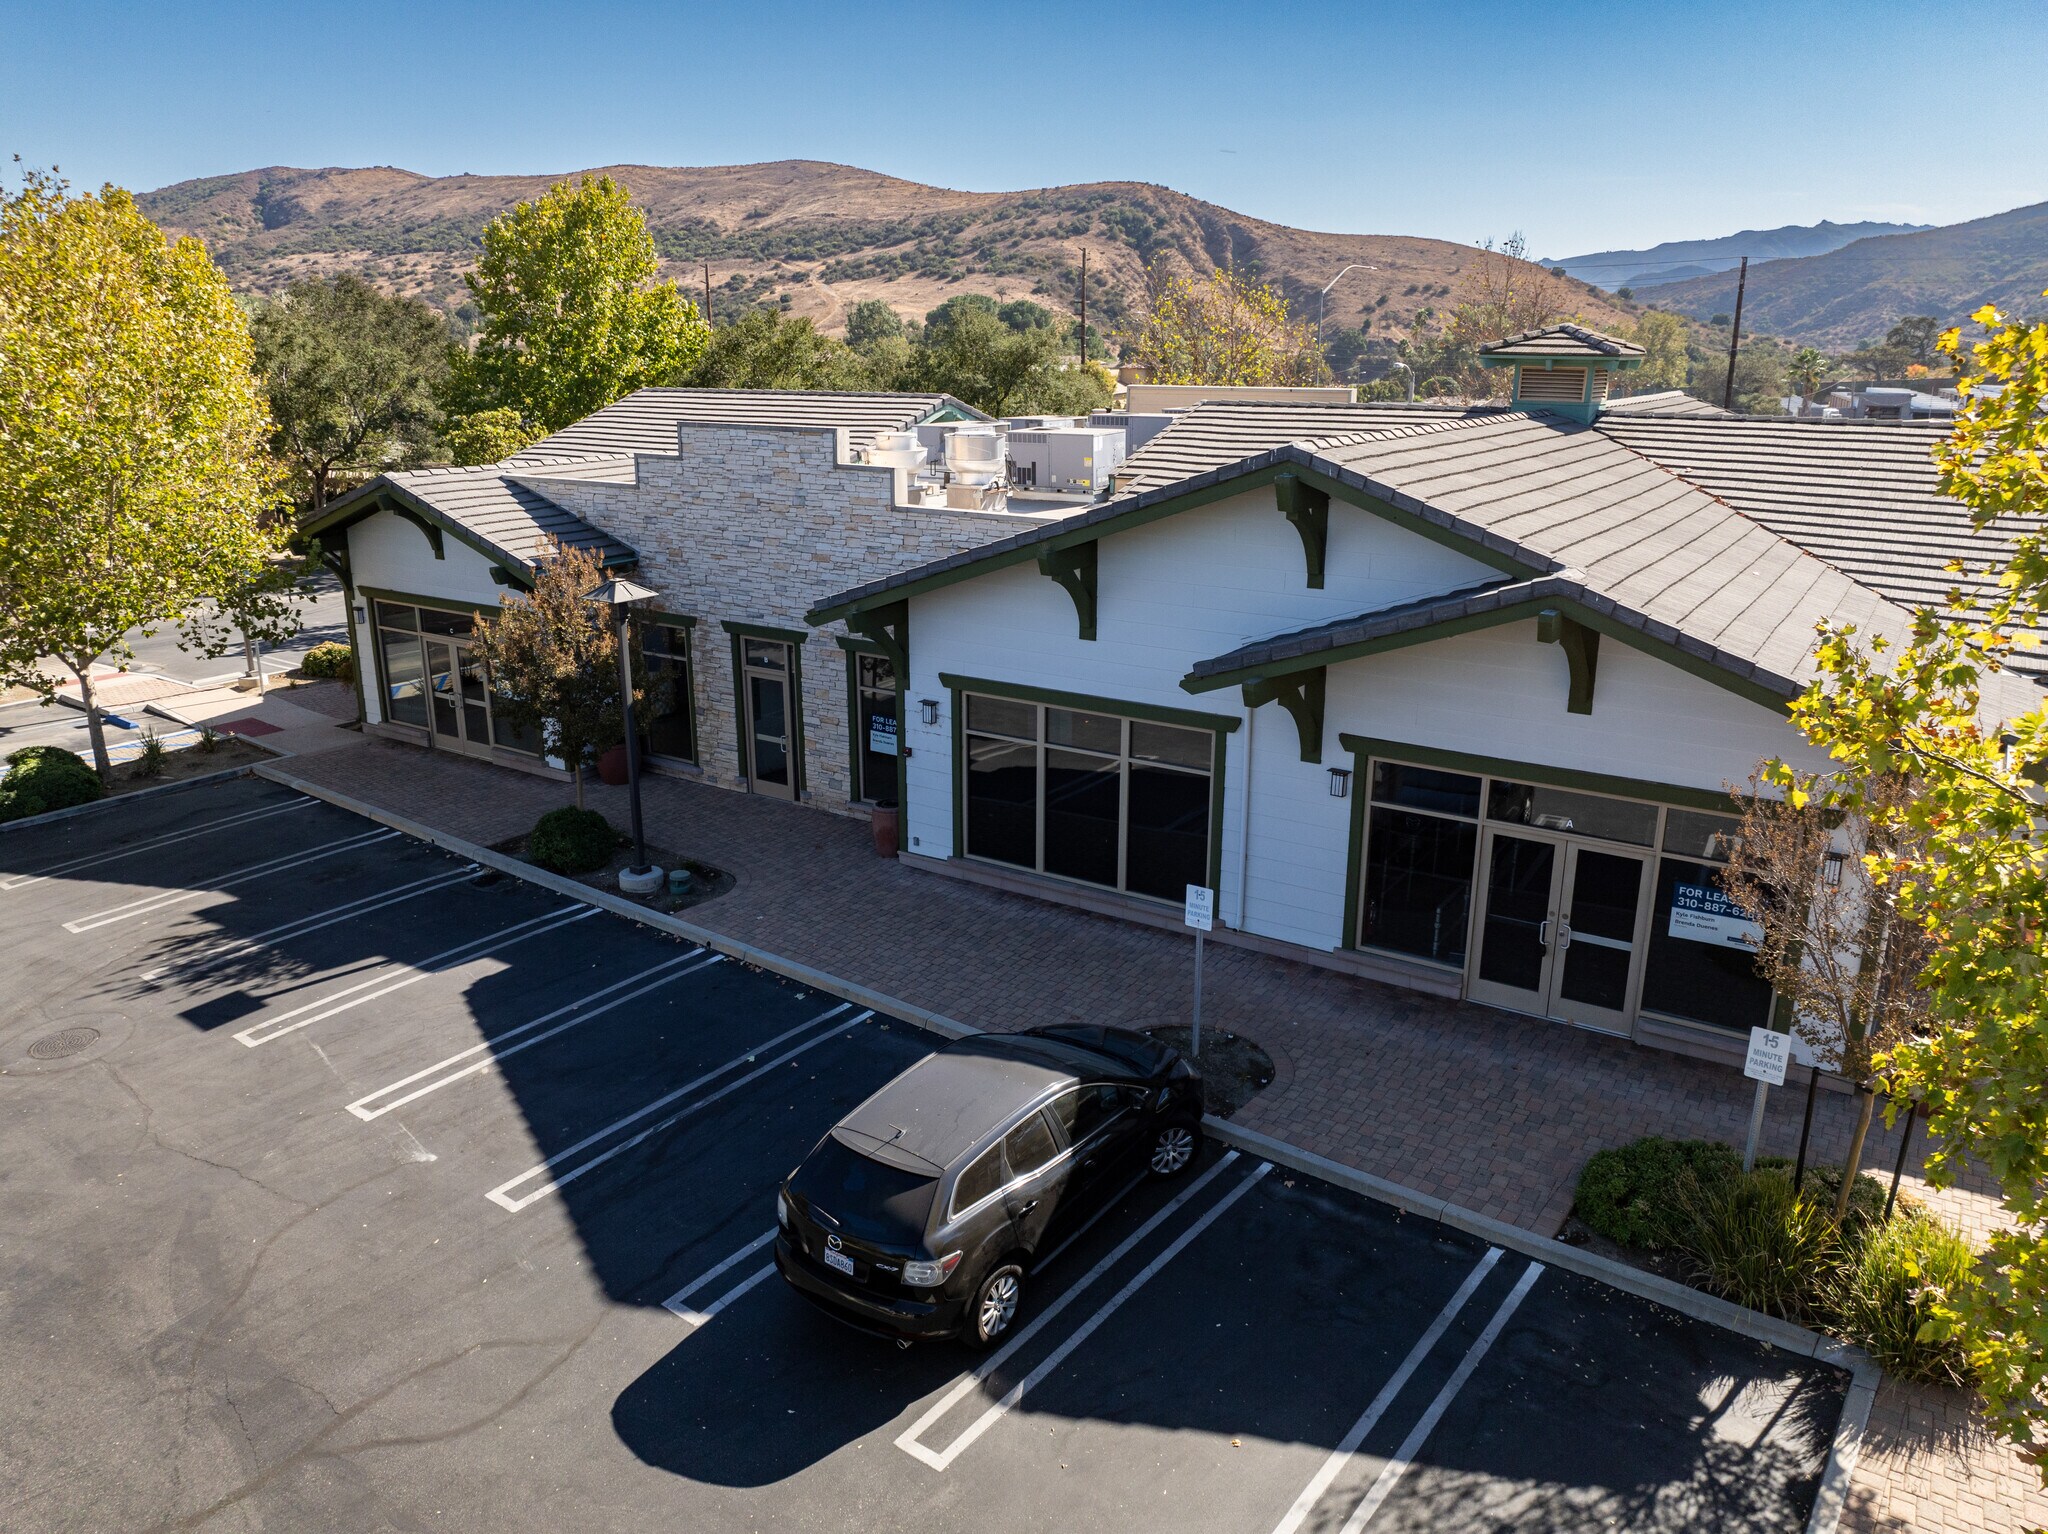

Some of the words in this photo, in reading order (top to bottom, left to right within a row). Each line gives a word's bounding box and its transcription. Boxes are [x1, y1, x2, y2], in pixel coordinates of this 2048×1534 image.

[872, 715, 885, 724] FOR
[1565, 819, 1574, 829] A
[1194, 889, 1206, 901] 15
[1678, 886, 1703, 899] FOR
[1189, 902, 1210, 912] MINUTE
[1677, 897, 1757, 919] 310-887-62
[1187, 909, 1211, 921] PARKING
[1675, 911, 1689, 919] Kyle
[1689, 914, 1715, 923] Fishburn
[1674, 919, 1696, 927] Brenda
[1763, 1033, 1779, 1049] 15
[1752, 1048, 1783, 1063] MINUTE
[1749, 1056, 1783, 1073] PARKING
